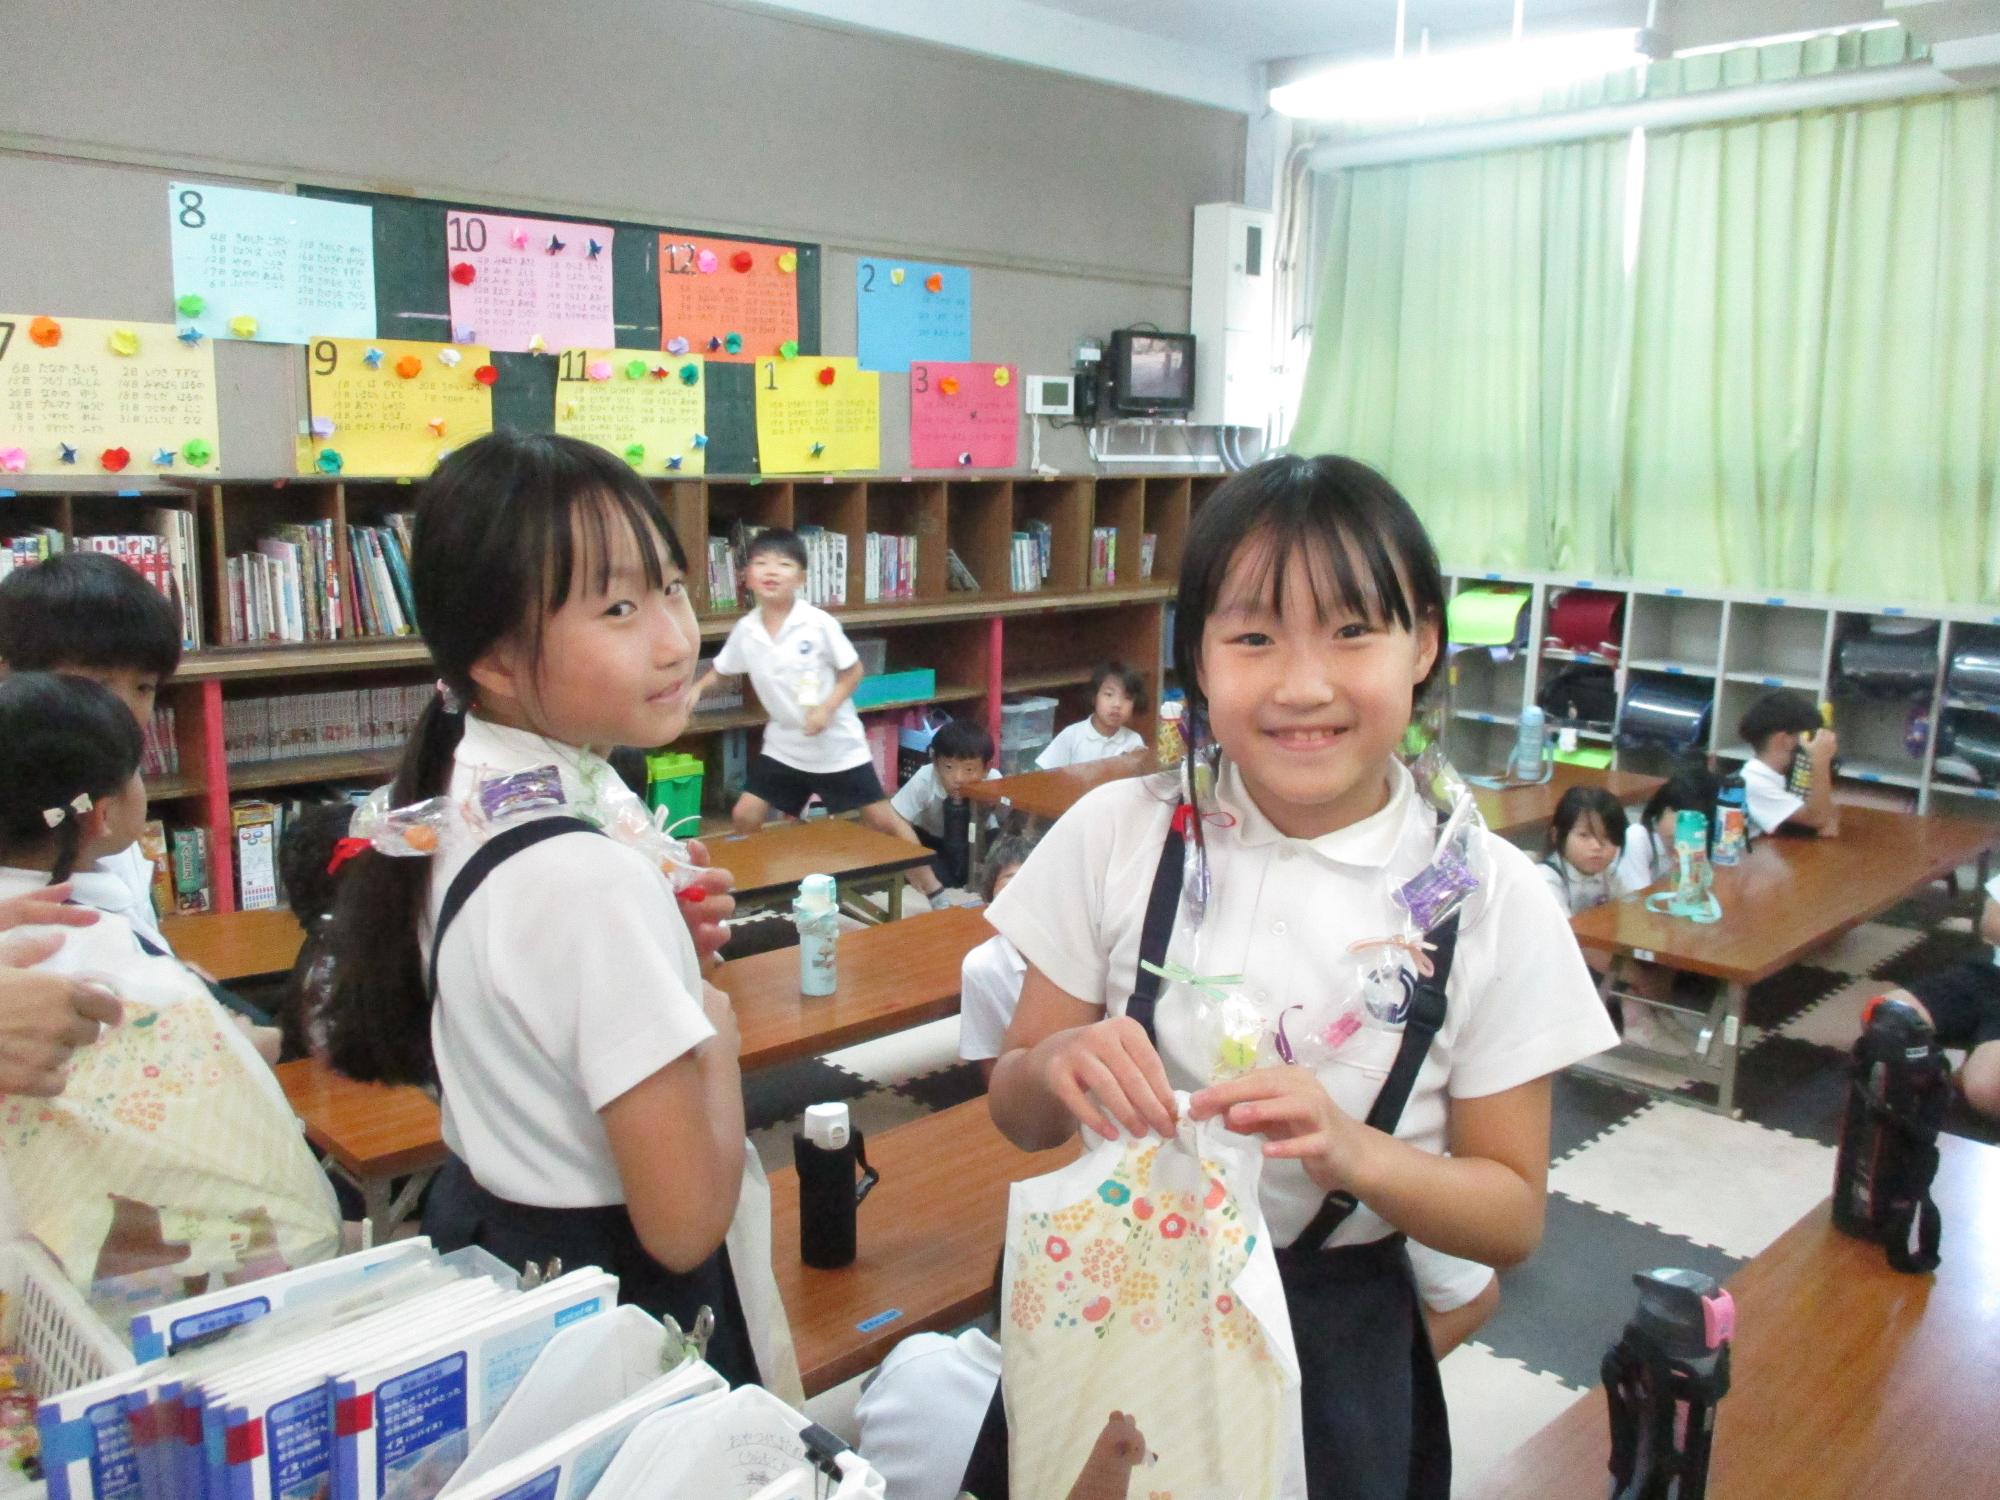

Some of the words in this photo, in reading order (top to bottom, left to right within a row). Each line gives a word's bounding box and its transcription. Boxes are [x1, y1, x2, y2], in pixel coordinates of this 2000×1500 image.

[179, 190, 206, 228] 8
[449, 217, 487, 252] 10
[665, 243, 697, 275] 12
[862, 264, 876, 293] 2
[0, 322, 15, 361] 7
[314, 340, 338, 376] 9
[560, 351, 590, 382] 11
[765, 362, 778, 390] 1
[915, 366, 929, 393] 3
